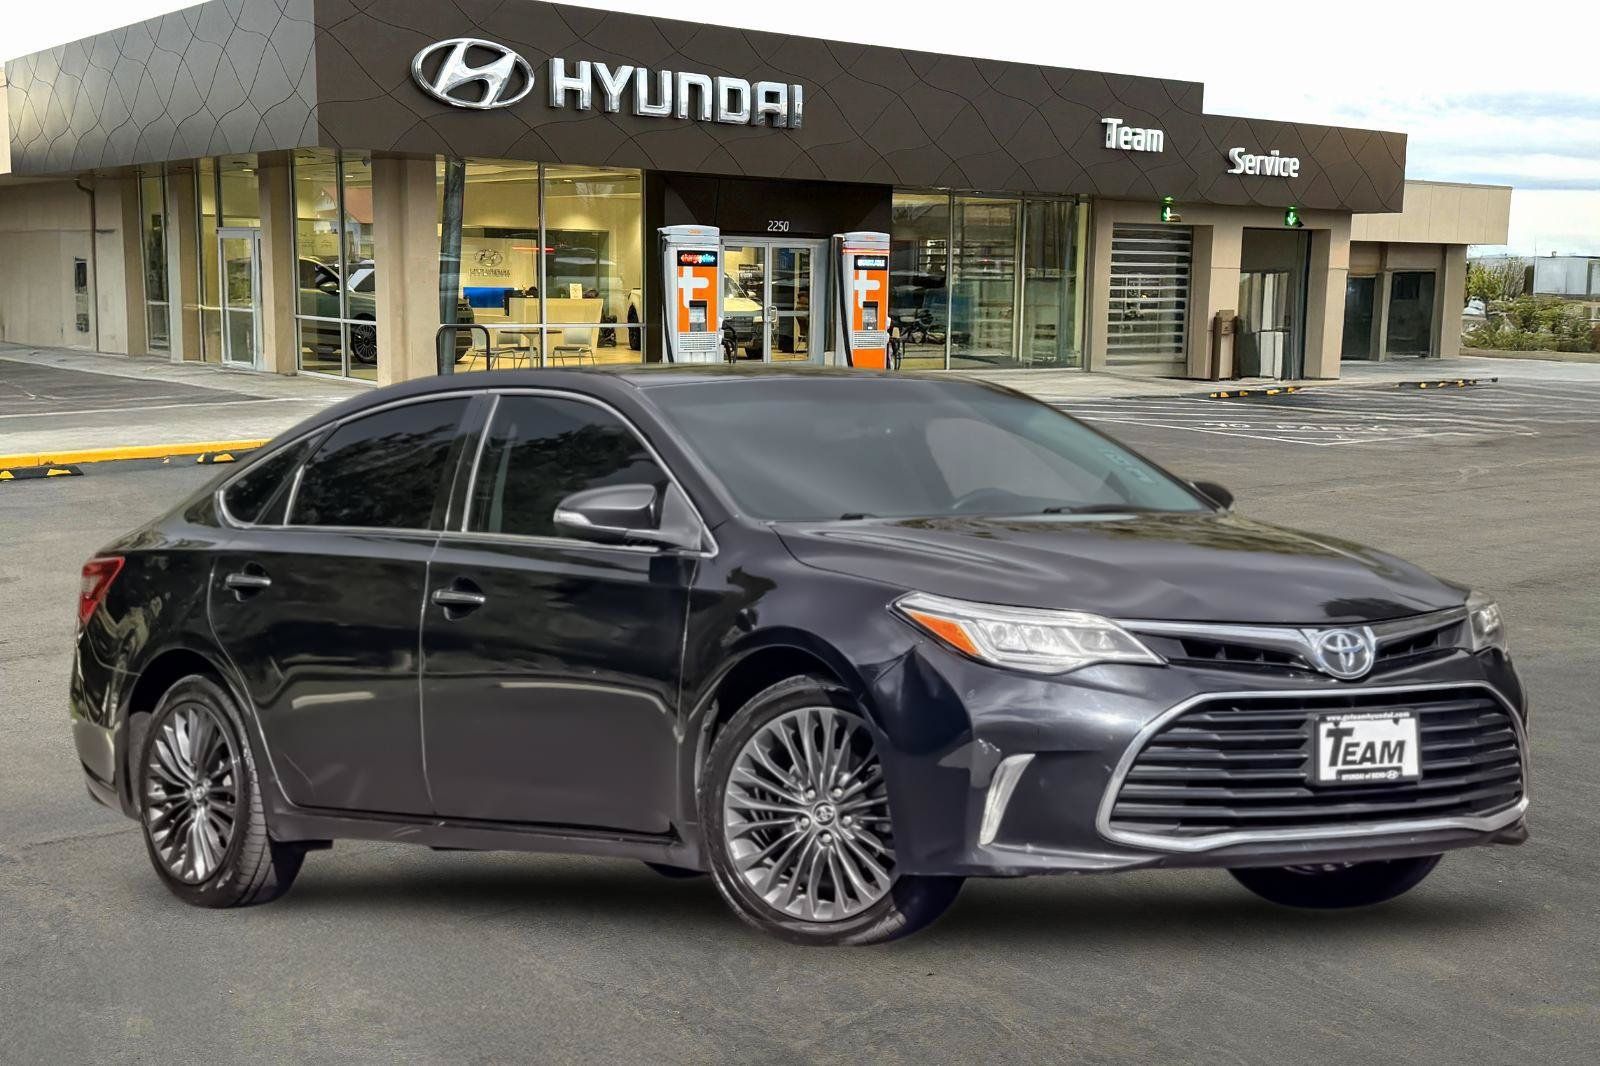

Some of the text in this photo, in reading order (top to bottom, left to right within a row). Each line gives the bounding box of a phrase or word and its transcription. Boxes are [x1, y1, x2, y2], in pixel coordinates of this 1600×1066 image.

[549, 57, 803, 129] HYUNDAI
[1101, 118, 1164, 153] Team
[1227, 147, 1300, 178] Service
[767, 220, 790, 232] 2250
[1325, 727, 1406, 767] TEAM
